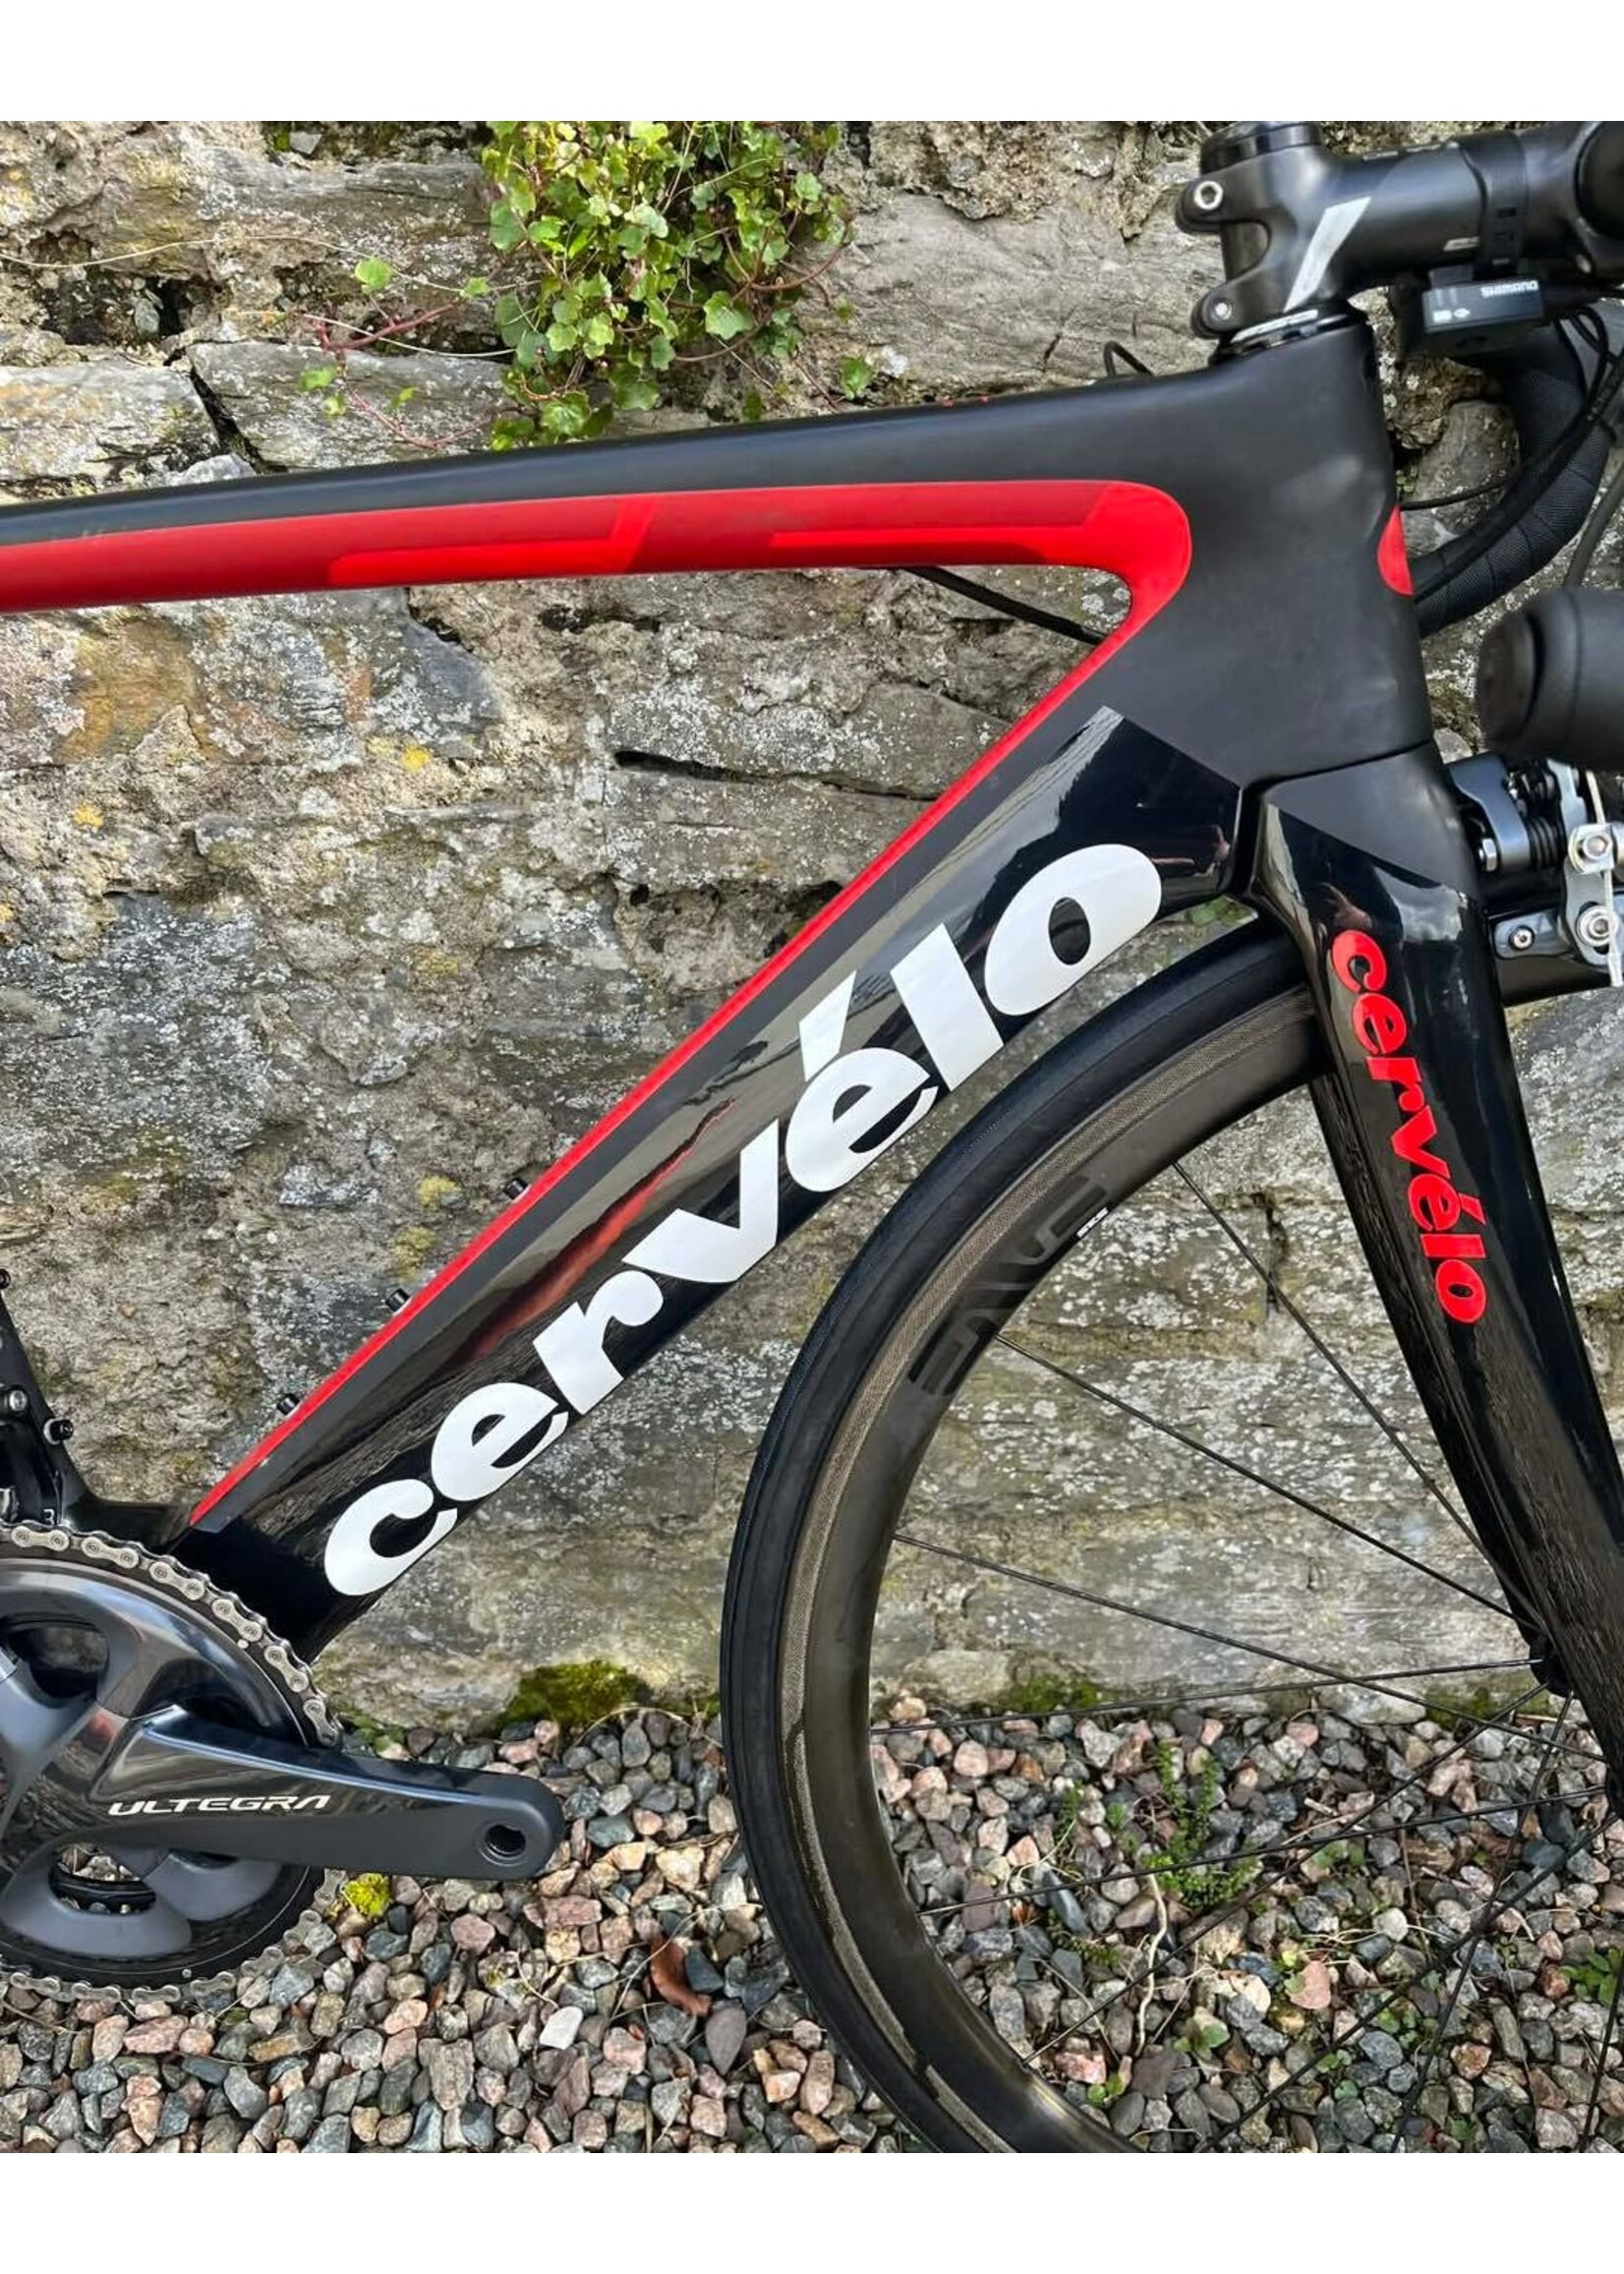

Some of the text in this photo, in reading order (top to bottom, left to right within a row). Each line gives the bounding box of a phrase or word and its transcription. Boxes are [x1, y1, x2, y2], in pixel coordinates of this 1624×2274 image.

[1479, 279, 1539, 298] SHIMANO
[323, 844, 1162, 1596] cervélo
[1331, 929, 1487, 1323] cervélo
[107, 1794, 332, 1816] ULTEGRA
